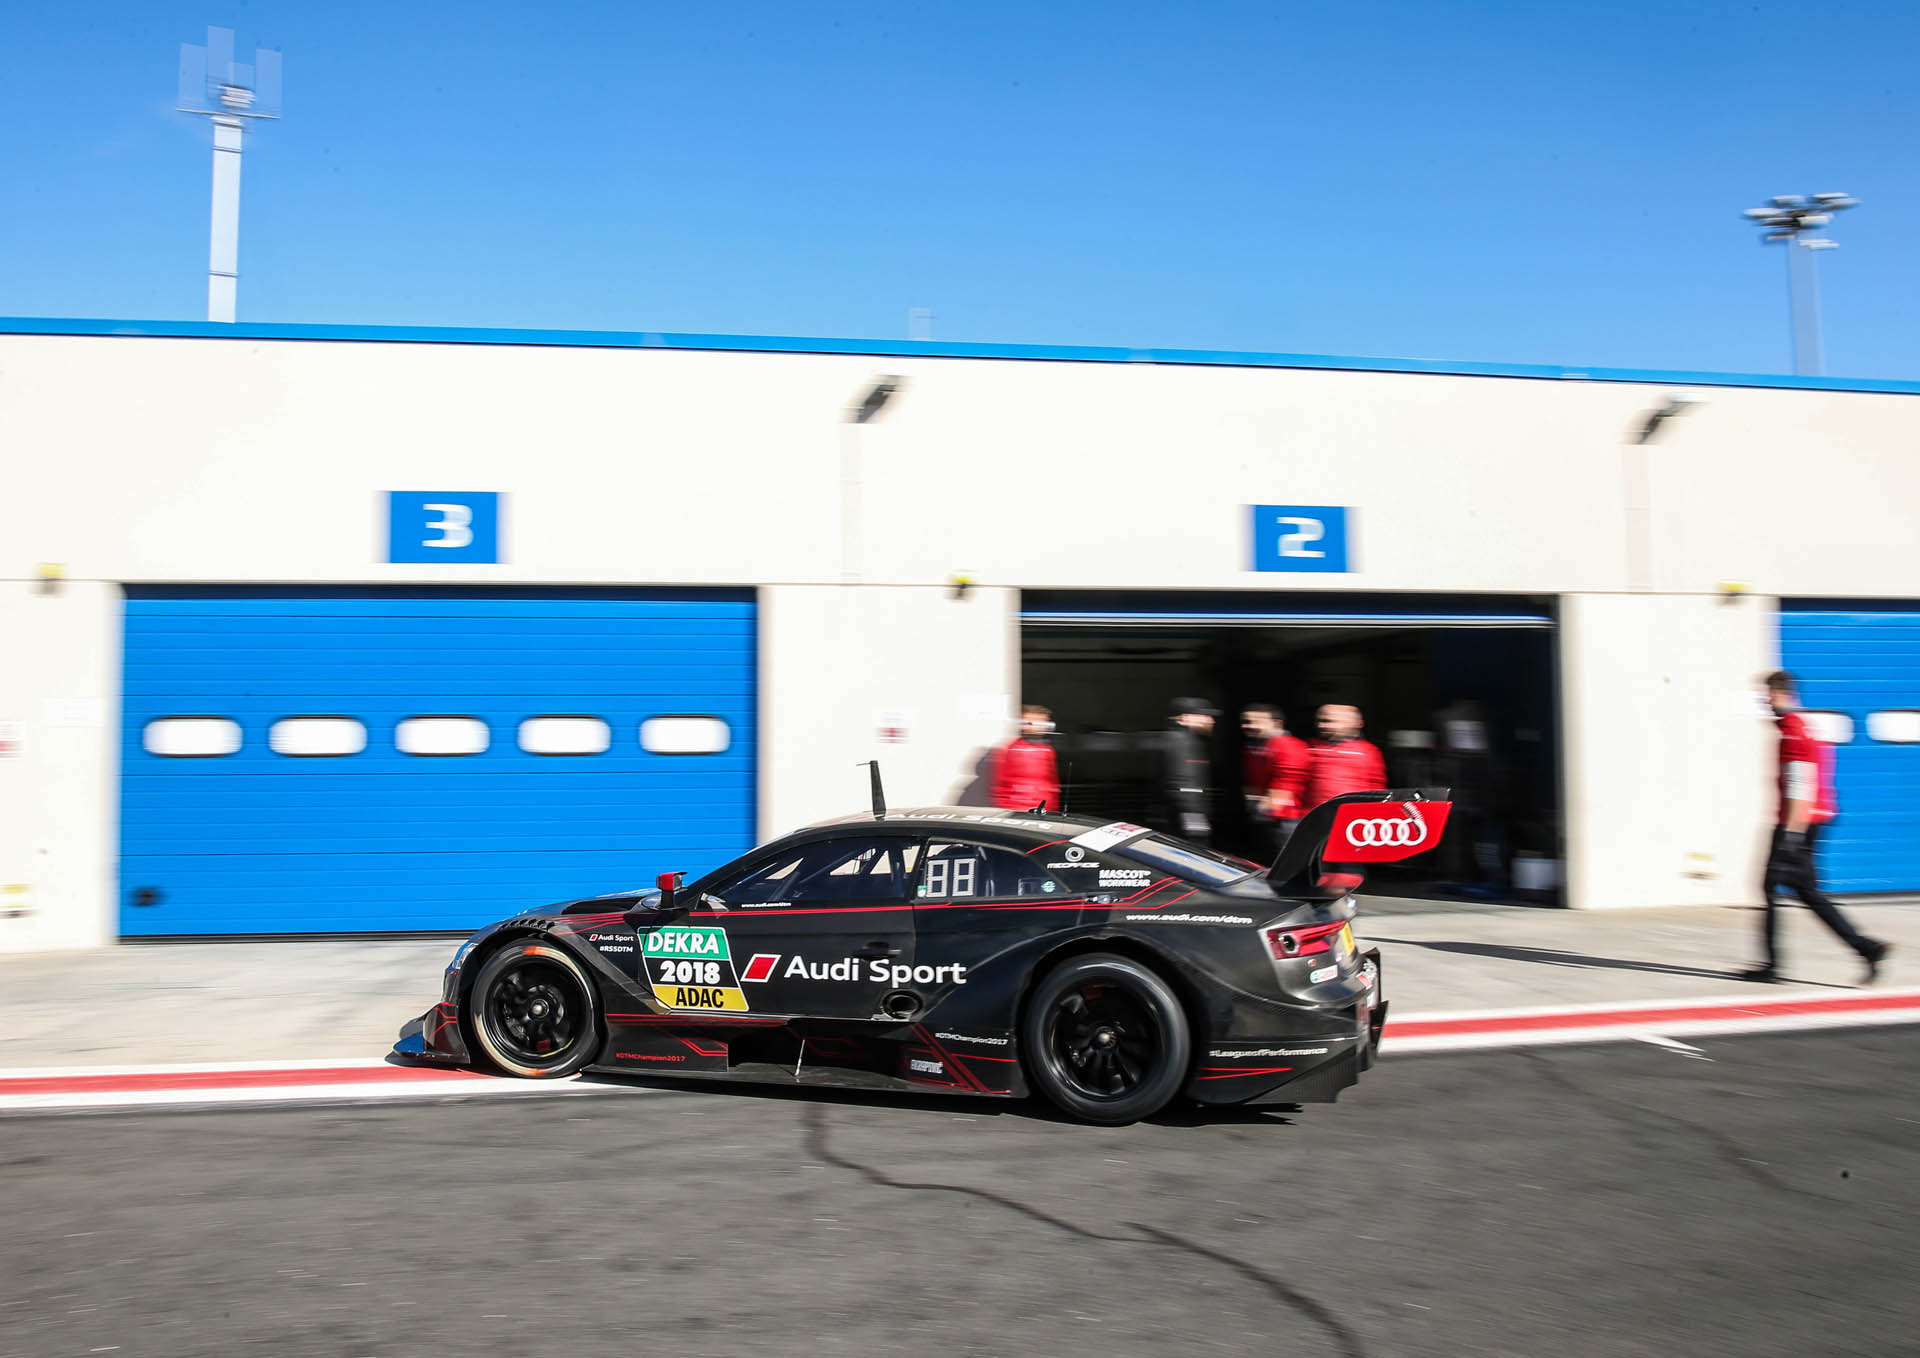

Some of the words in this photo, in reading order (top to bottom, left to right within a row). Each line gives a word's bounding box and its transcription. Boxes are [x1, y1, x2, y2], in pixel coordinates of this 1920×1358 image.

[422, 503, 473, 548] 3
[1276, 516, 1326, 558] 2
[961, 815, 1053, 830] Sport
[926, 858, 976, 898] 88
[1099, 879, 1151, 888] WORKWEAR
[1126, 914, 1253, 924] www.audi.com/dtm
[598, 934, 614, 942] Audi
[615, 934, 634, 944] Sport
[647, 932, 719, 954] DEKRA
[660, 960, 720, 984] 2018
[784, 955, 859, 981] Audi
[869, 958, 967, 988] Sport
[675, 987, 724, 1008] ADAC
